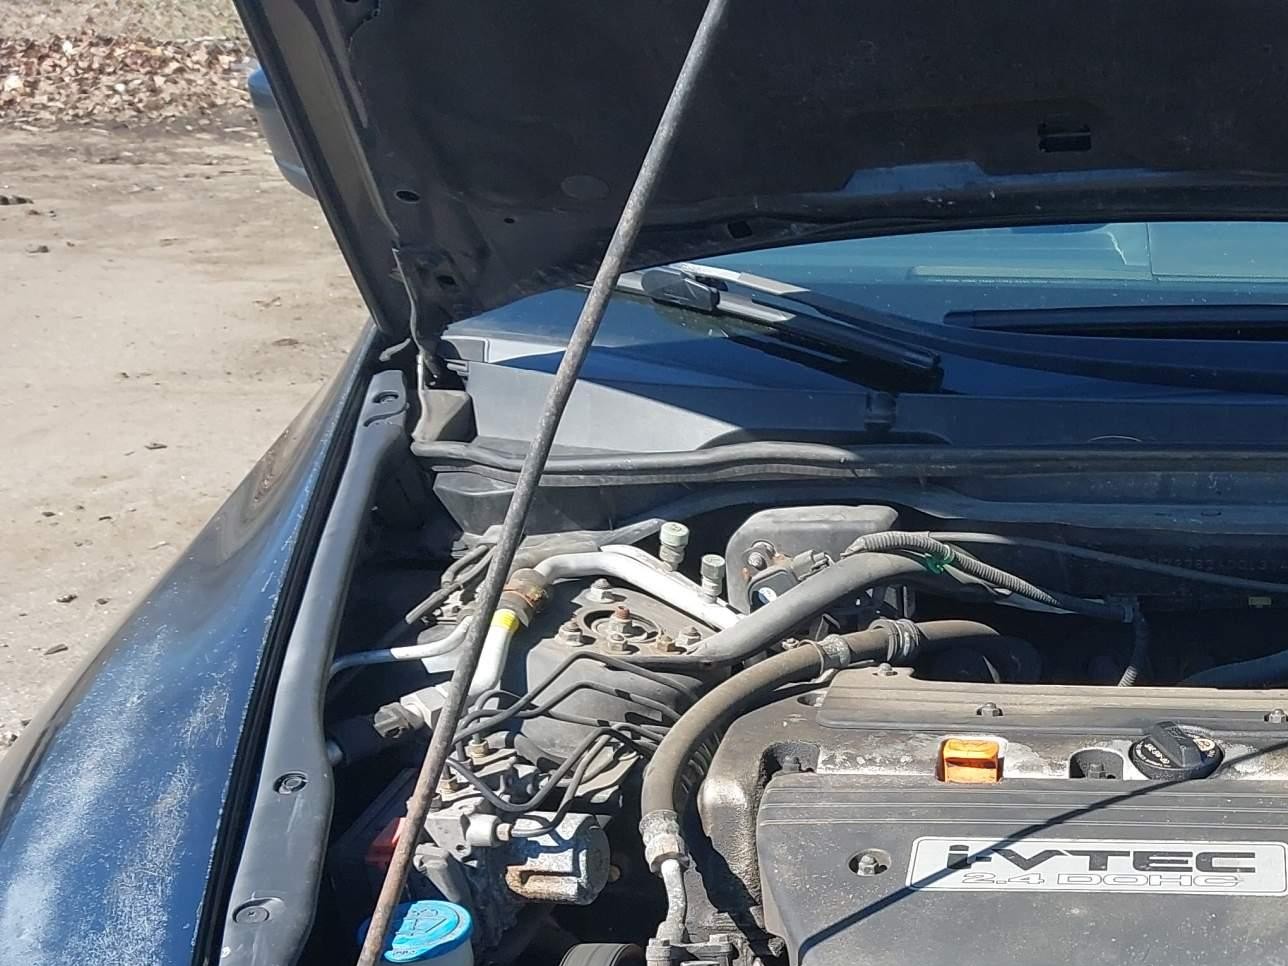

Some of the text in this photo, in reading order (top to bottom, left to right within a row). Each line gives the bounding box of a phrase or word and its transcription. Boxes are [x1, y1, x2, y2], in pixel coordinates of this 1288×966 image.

[947, 844, 1256, 873] i-VTEC
[961, 872, 1242, 888] 2.4 DOHC
